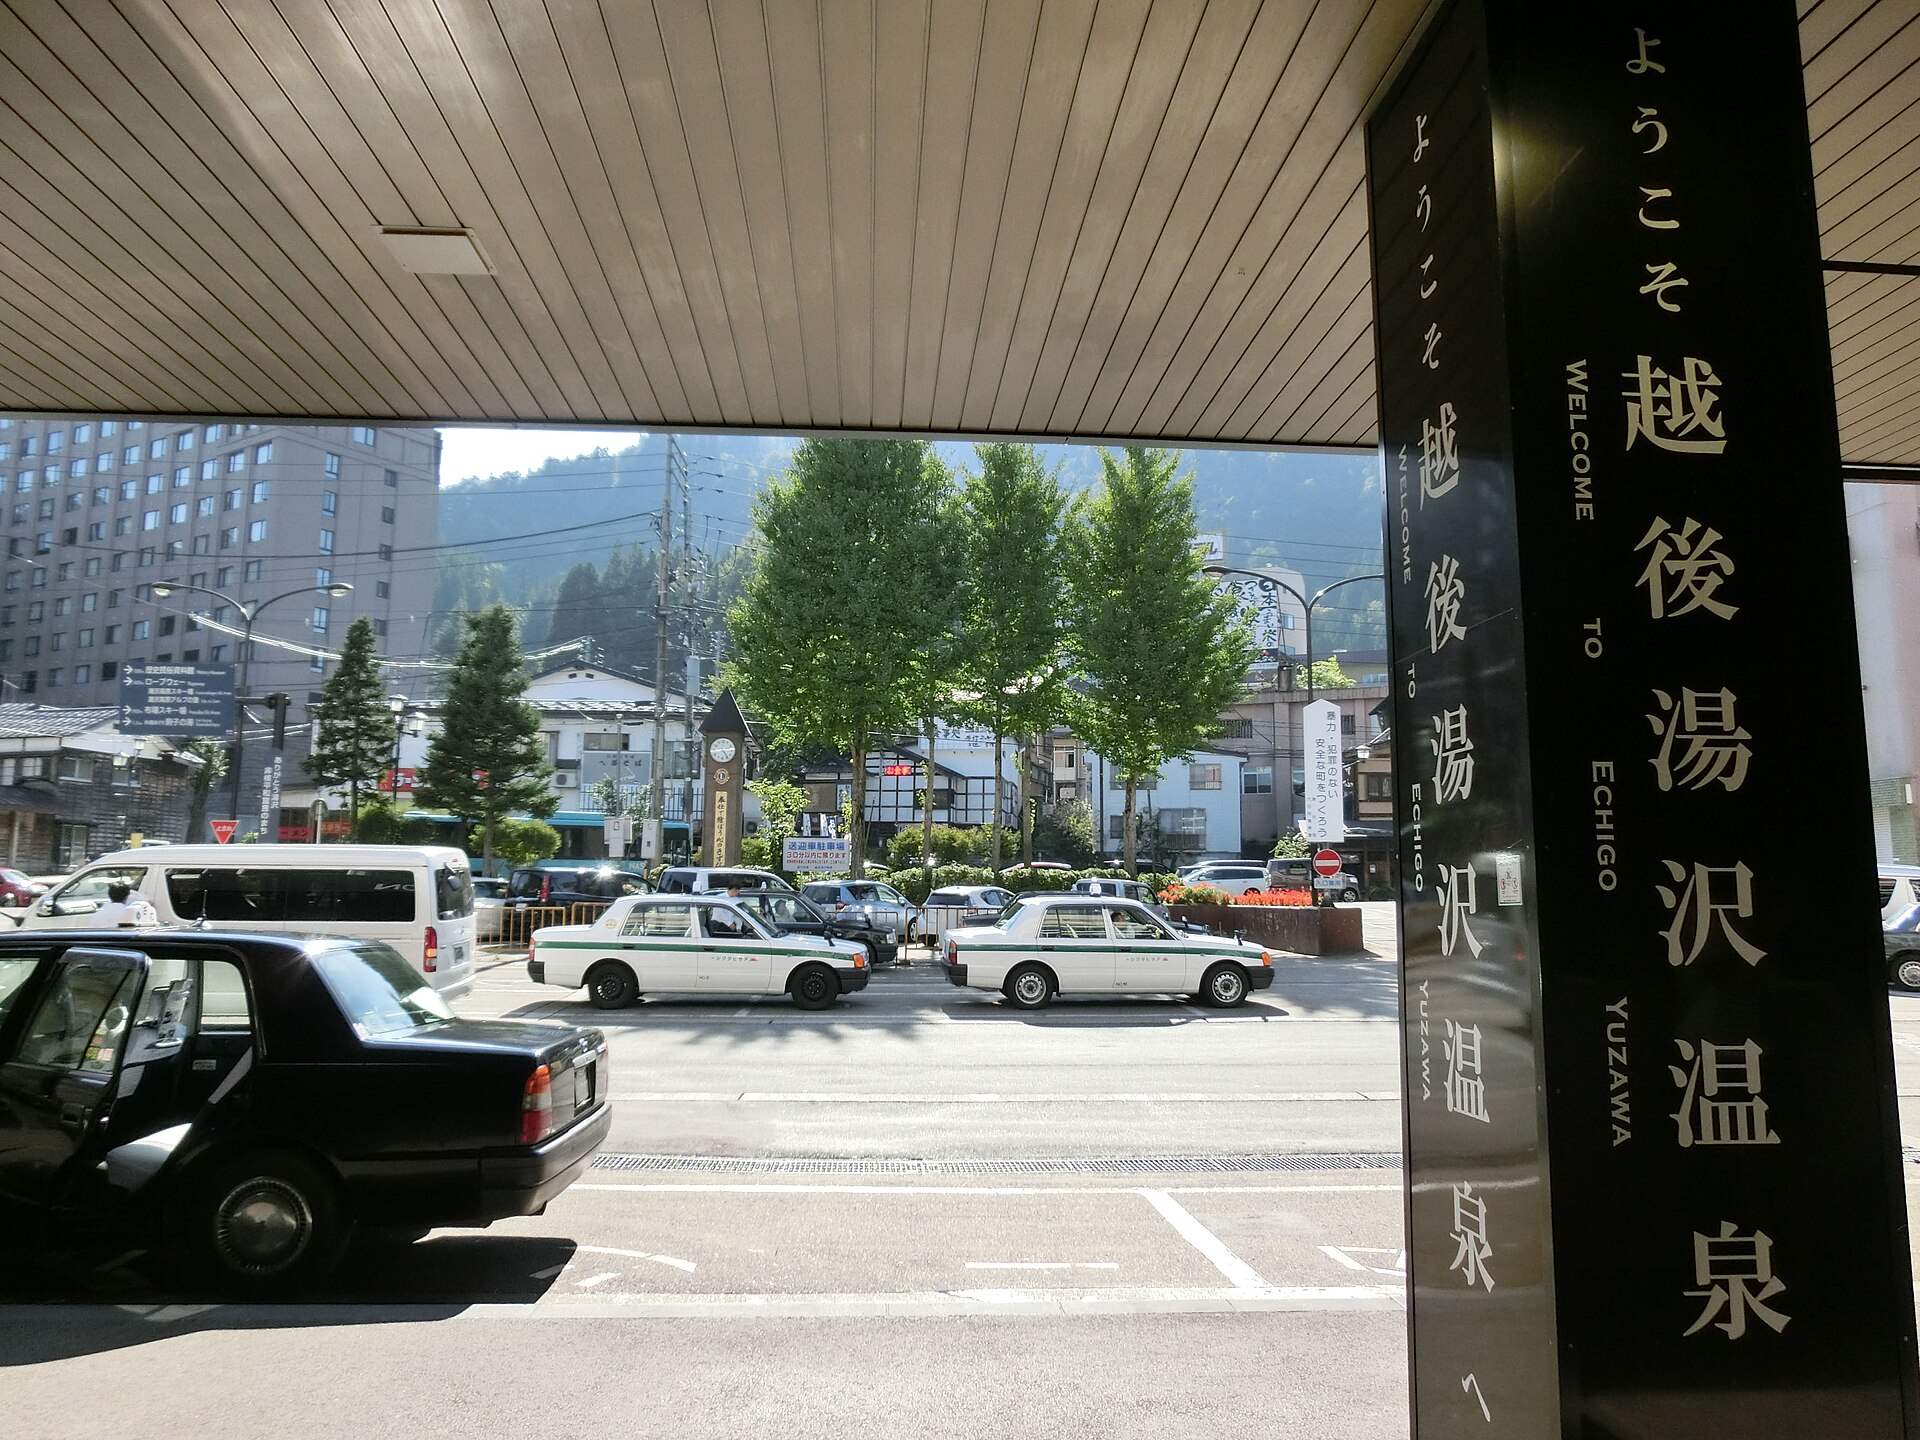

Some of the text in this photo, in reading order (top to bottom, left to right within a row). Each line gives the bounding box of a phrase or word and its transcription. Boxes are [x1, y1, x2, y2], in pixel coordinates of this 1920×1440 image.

[1315, 738, 1328, 838] 安全な町をつくろう
[1326, 711, 1338, 799] 暴力・犯罪のない
[1397, 444, 1432, 1102] WELCOME TO ECHIGO YUZAWA
[1565, 359, 1632, 1148] WELCOME TO ECHIGO YUZAWA
[788, 841, 845, 850] 送迎車駐車場
